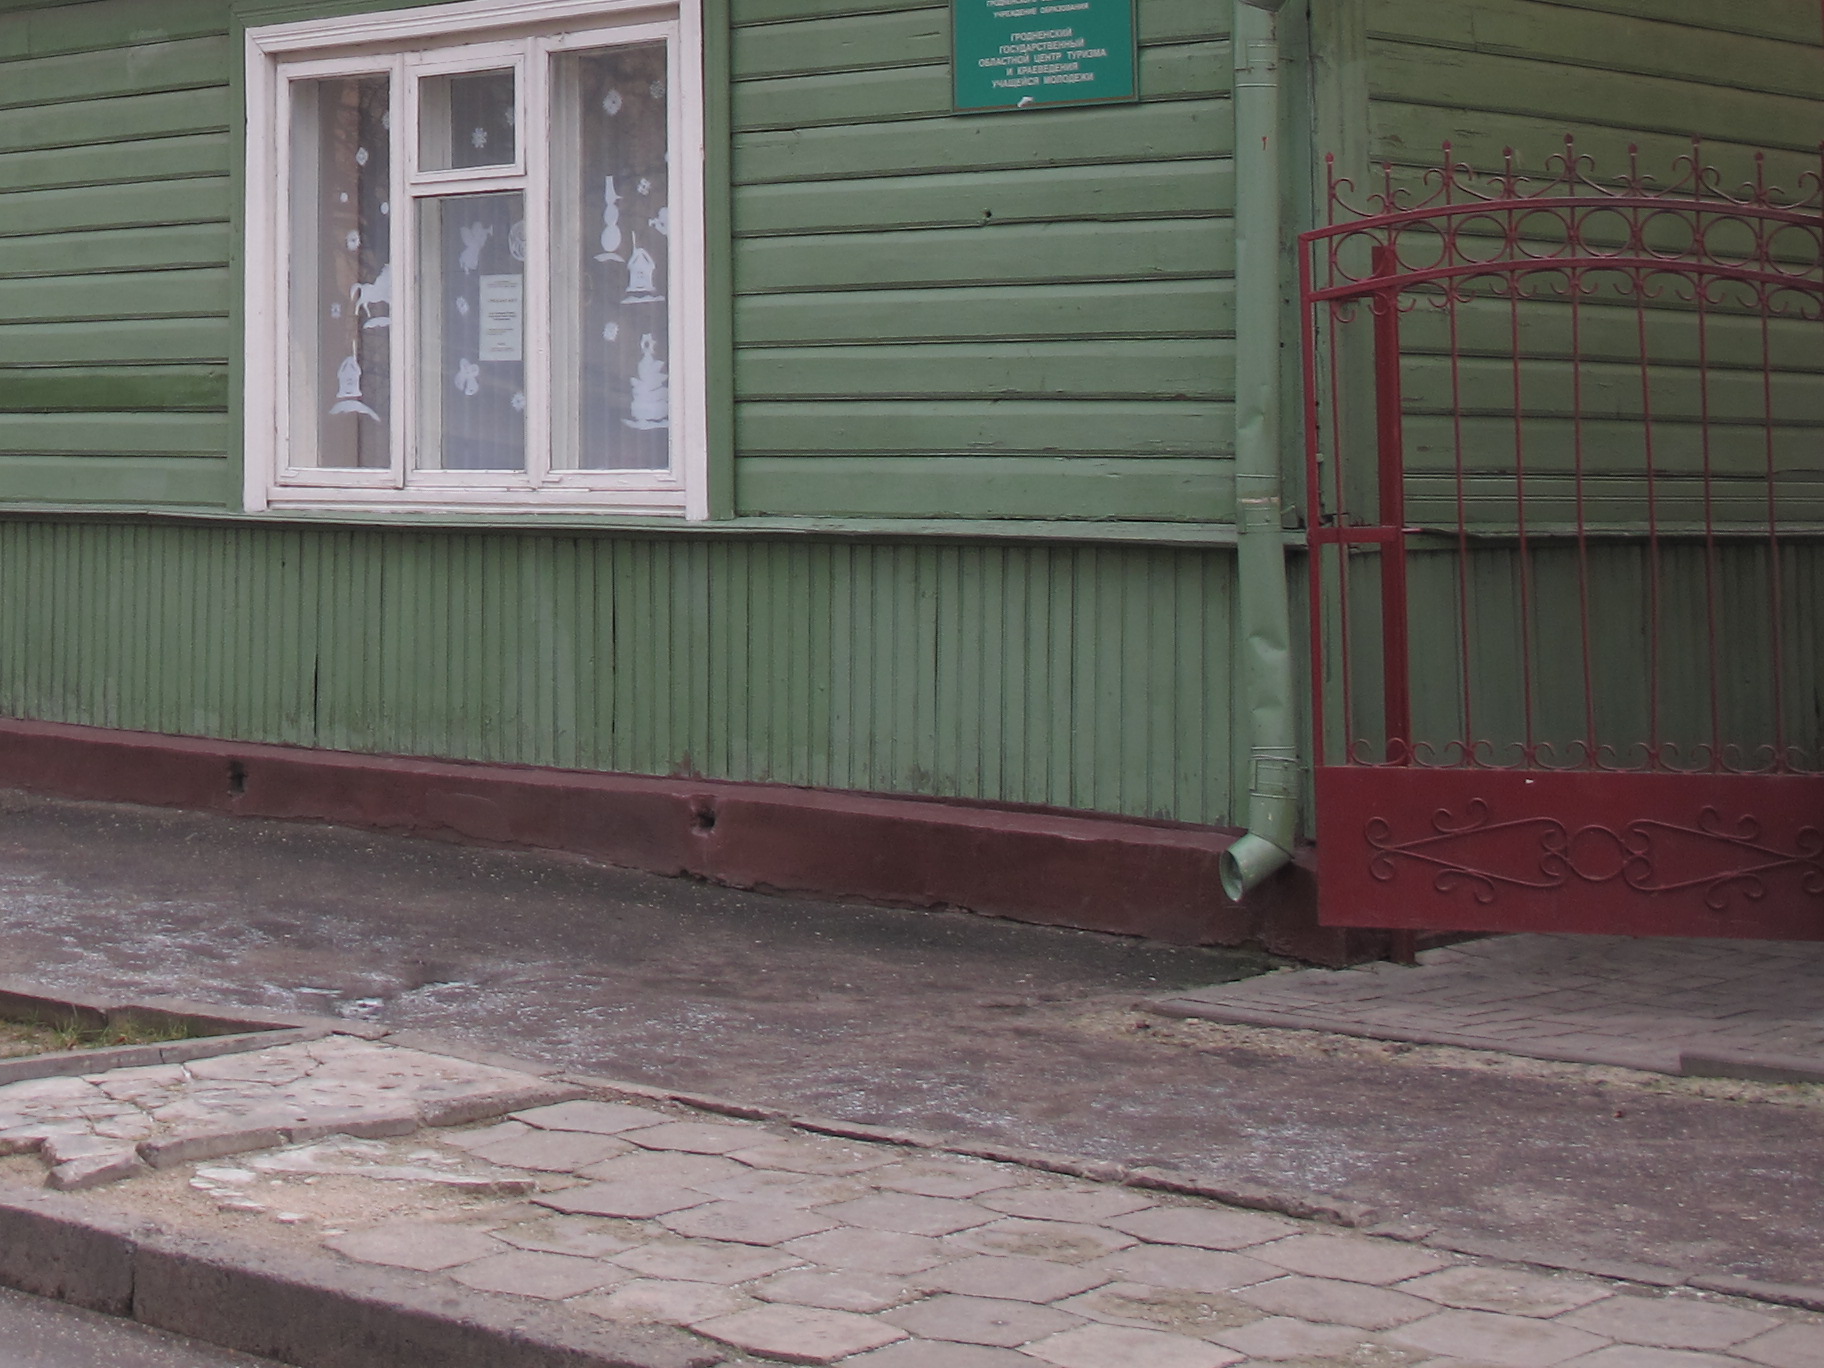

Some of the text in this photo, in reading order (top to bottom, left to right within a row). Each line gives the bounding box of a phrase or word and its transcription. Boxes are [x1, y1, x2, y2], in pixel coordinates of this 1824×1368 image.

[1010, 27, 1073, 42] ГРОДНЕНСКИЙ
[999, 38, 1085, 54] ГОСУДАРСТВЕННЫЙ
[978, 48, 1107, 67] ОБЛАСТНОЙ ЦЕНТР ТУРИЗМА
[1006, 62, 1078, 76] И КРАЕВЕДЕНИЯ
[992, 76, 1039, 88] УЧАЩЕЙСЯ
